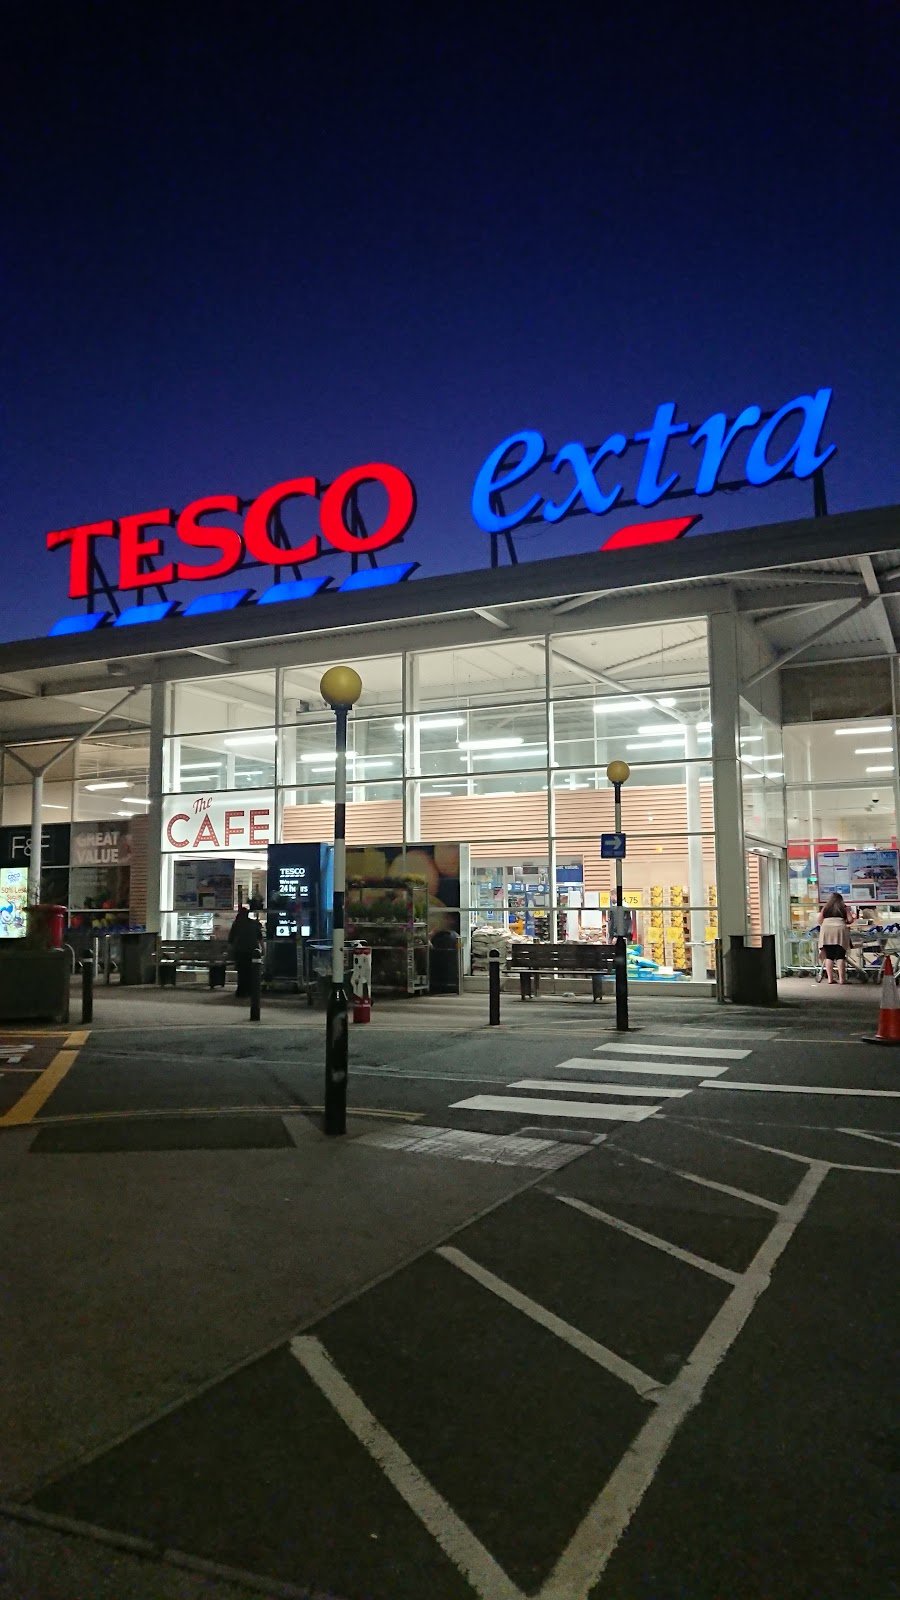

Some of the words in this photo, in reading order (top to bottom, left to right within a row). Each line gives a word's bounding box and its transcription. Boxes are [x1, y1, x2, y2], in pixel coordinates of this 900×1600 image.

[46, 462, 417, 599] TESCO
[471, 386, 837, 534] extra
[192, 797, 213, 815] The
[166, 808, 270, 848] CAFE
[77, 831, 120, 847] GREAT
[77, 848, 119, 863] VALUE
[279, 867, 306, 876] TESCO
[279, 884, 288, 893] 24
[289, 884, 309, 893] hrs
